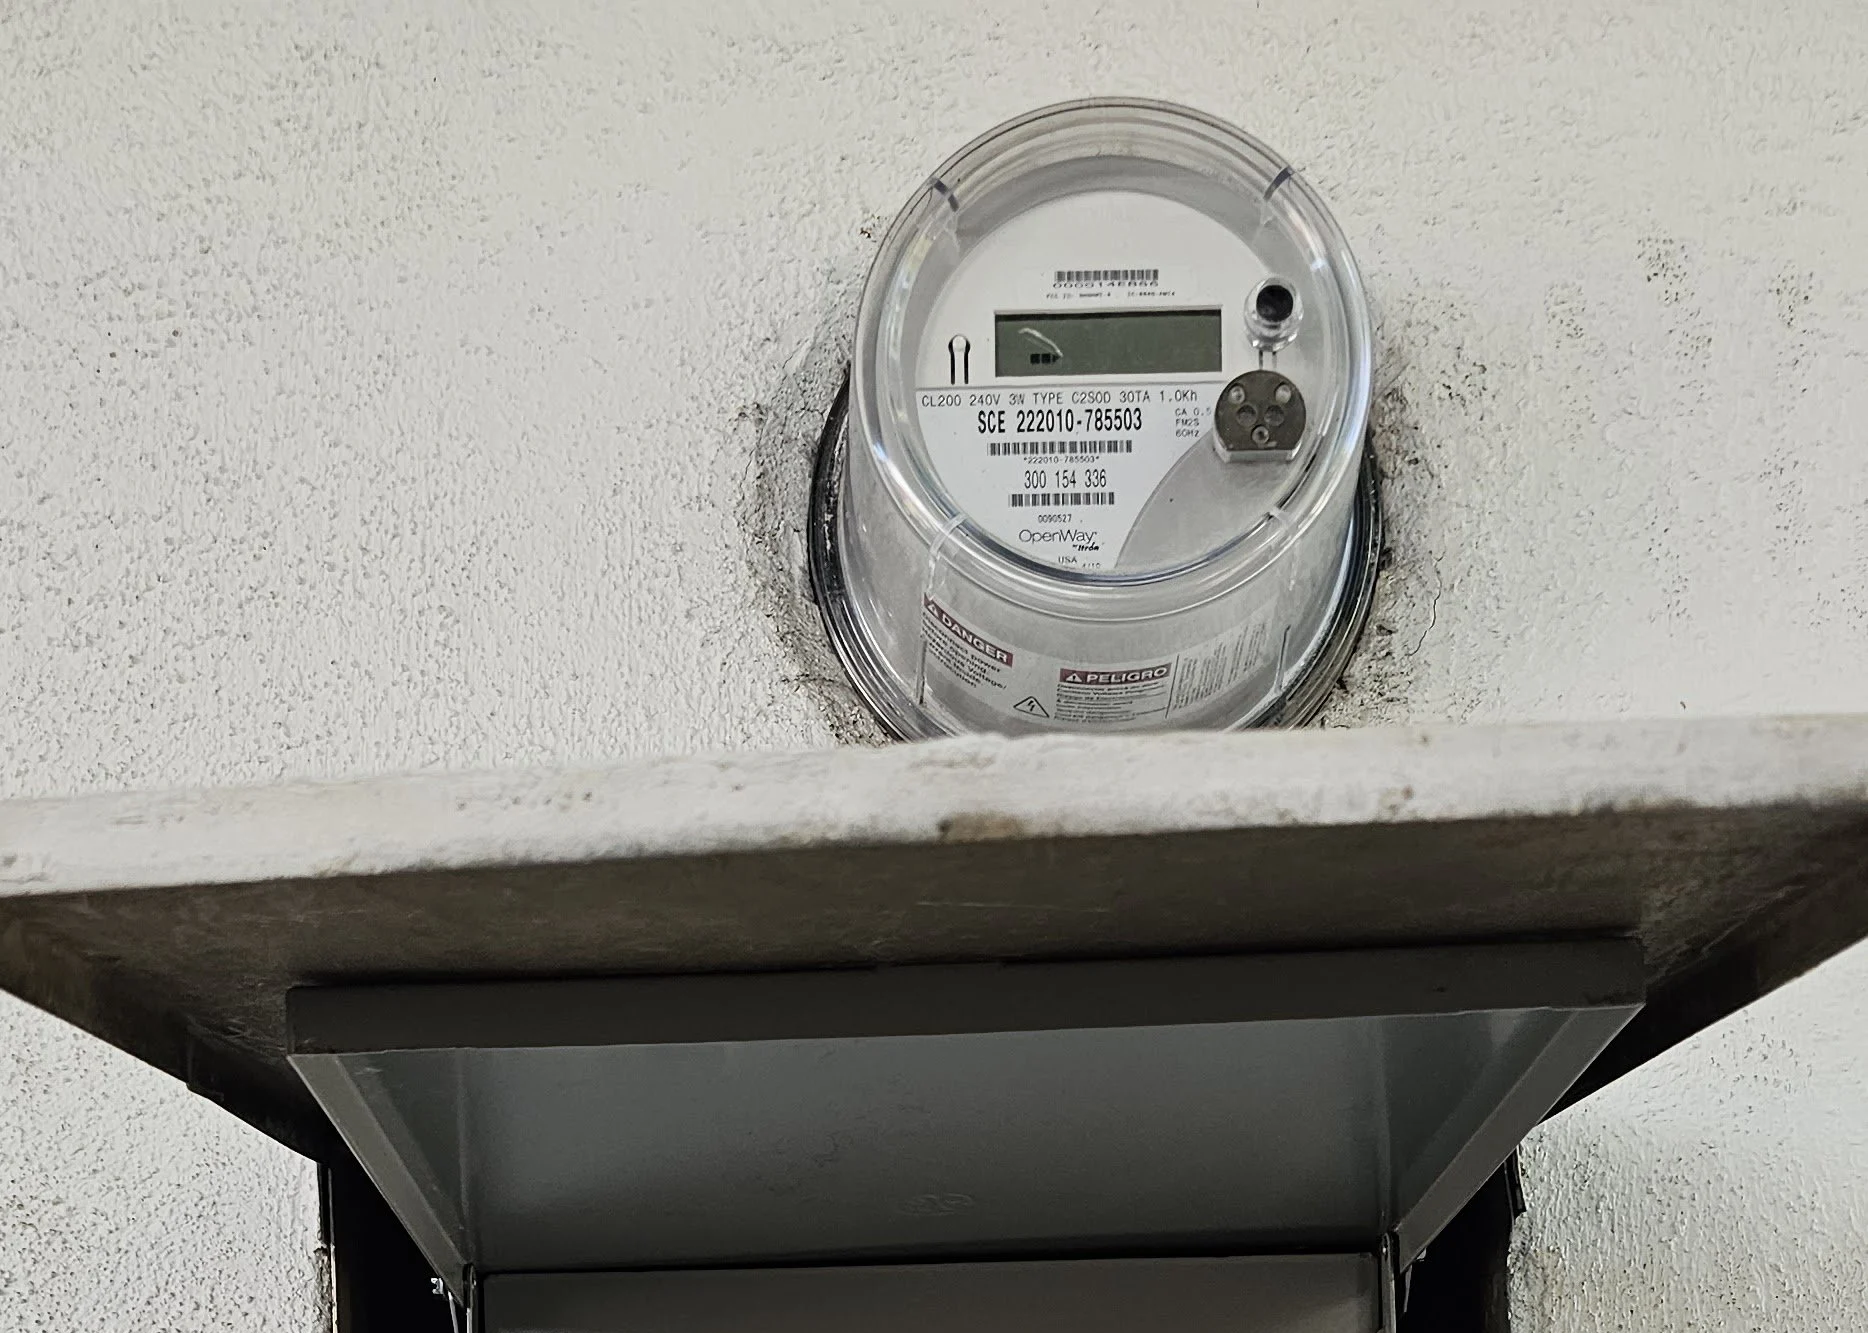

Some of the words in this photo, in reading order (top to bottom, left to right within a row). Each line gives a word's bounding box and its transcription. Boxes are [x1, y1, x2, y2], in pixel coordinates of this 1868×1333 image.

[921, 394, 961, 407] CL200
[969, 393, 1000, 407] 240V
[1032, 391, 1064, 405] TYPE
[978, 409, 1006, 434] SCE
[1017, 407, 1142, 432] 222010-785503
[1024, 469, 1047, 489] 300
[1055, 469, 1076, 488] 154
[1084, 469, 1107, 488] 336
[942, 613, 1008, 663] DANGER
[1087, 667, 1167, 683] PELIGRO
